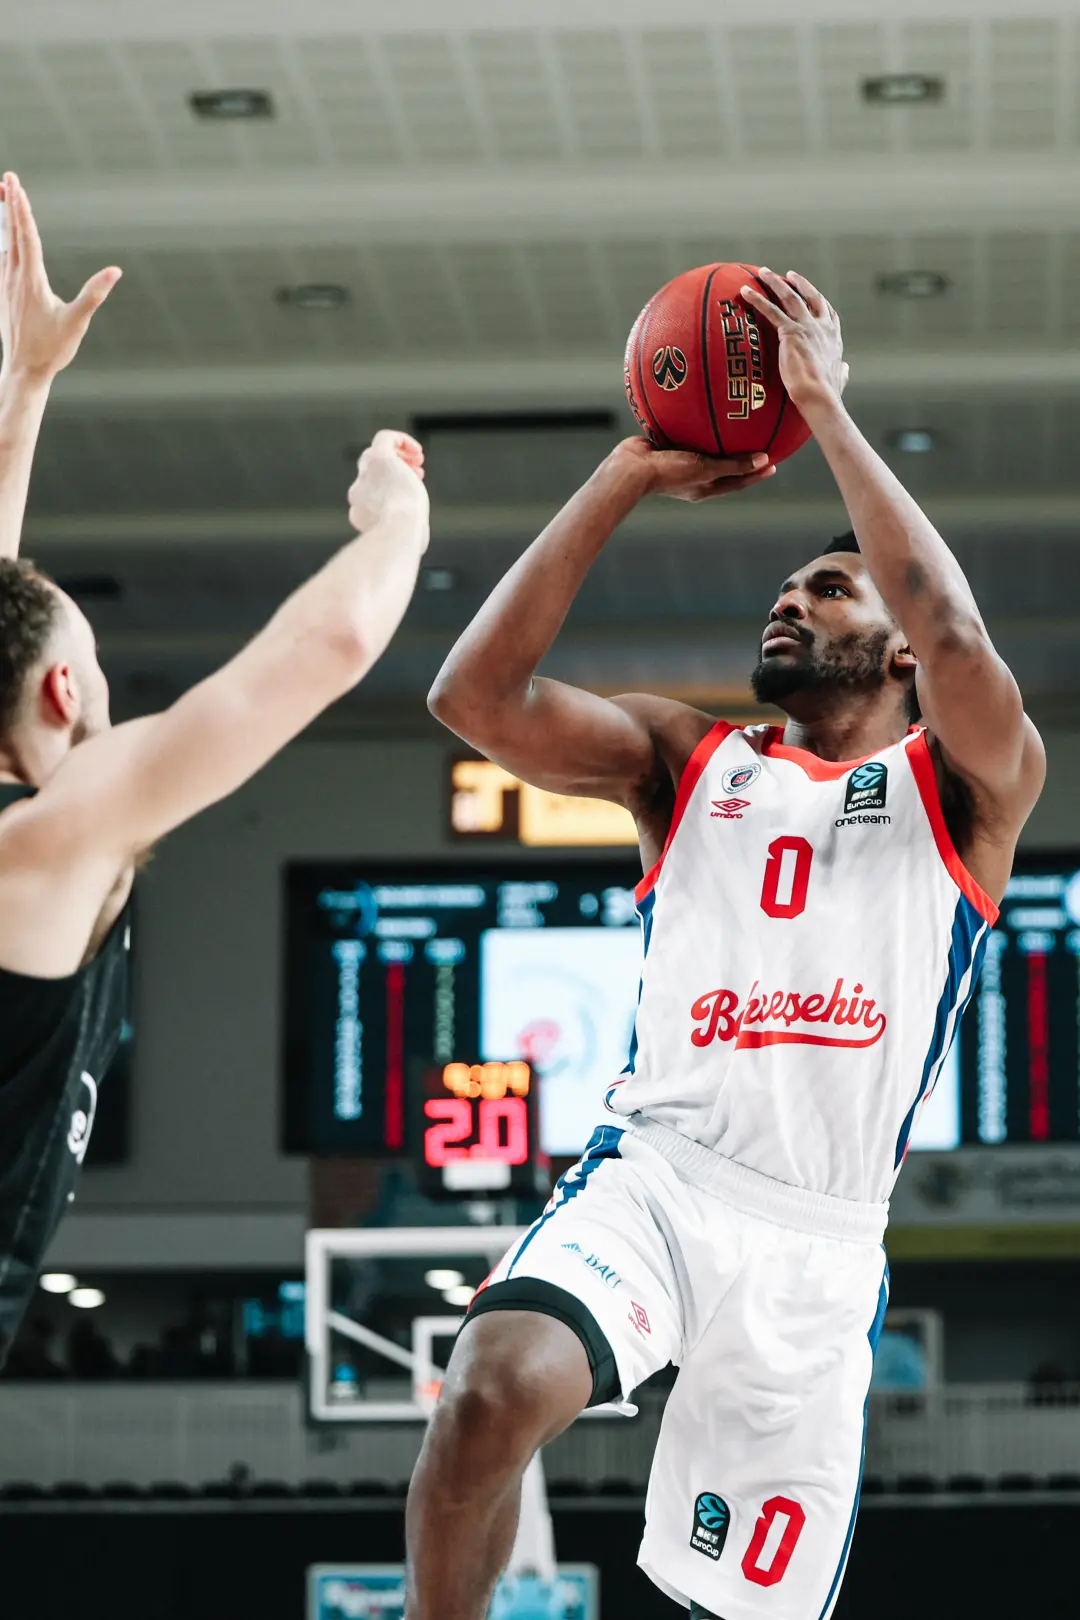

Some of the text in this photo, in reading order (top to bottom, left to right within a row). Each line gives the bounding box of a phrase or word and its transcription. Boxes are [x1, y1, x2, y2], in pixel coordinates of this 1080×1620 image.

[717, 299, 749, 419] LEGACY
[710, 811, 743, 819] umbro
[846, 798, 882, 810] EuroCup
[760, 836, 814, 919] 0
[585, 1253, 622, 1288] BAU
[692, 1537, 719, 1557] EuroCup
[696, 1527, 720, 1544] BKT
[741, 1495, 806, 1587] 0
